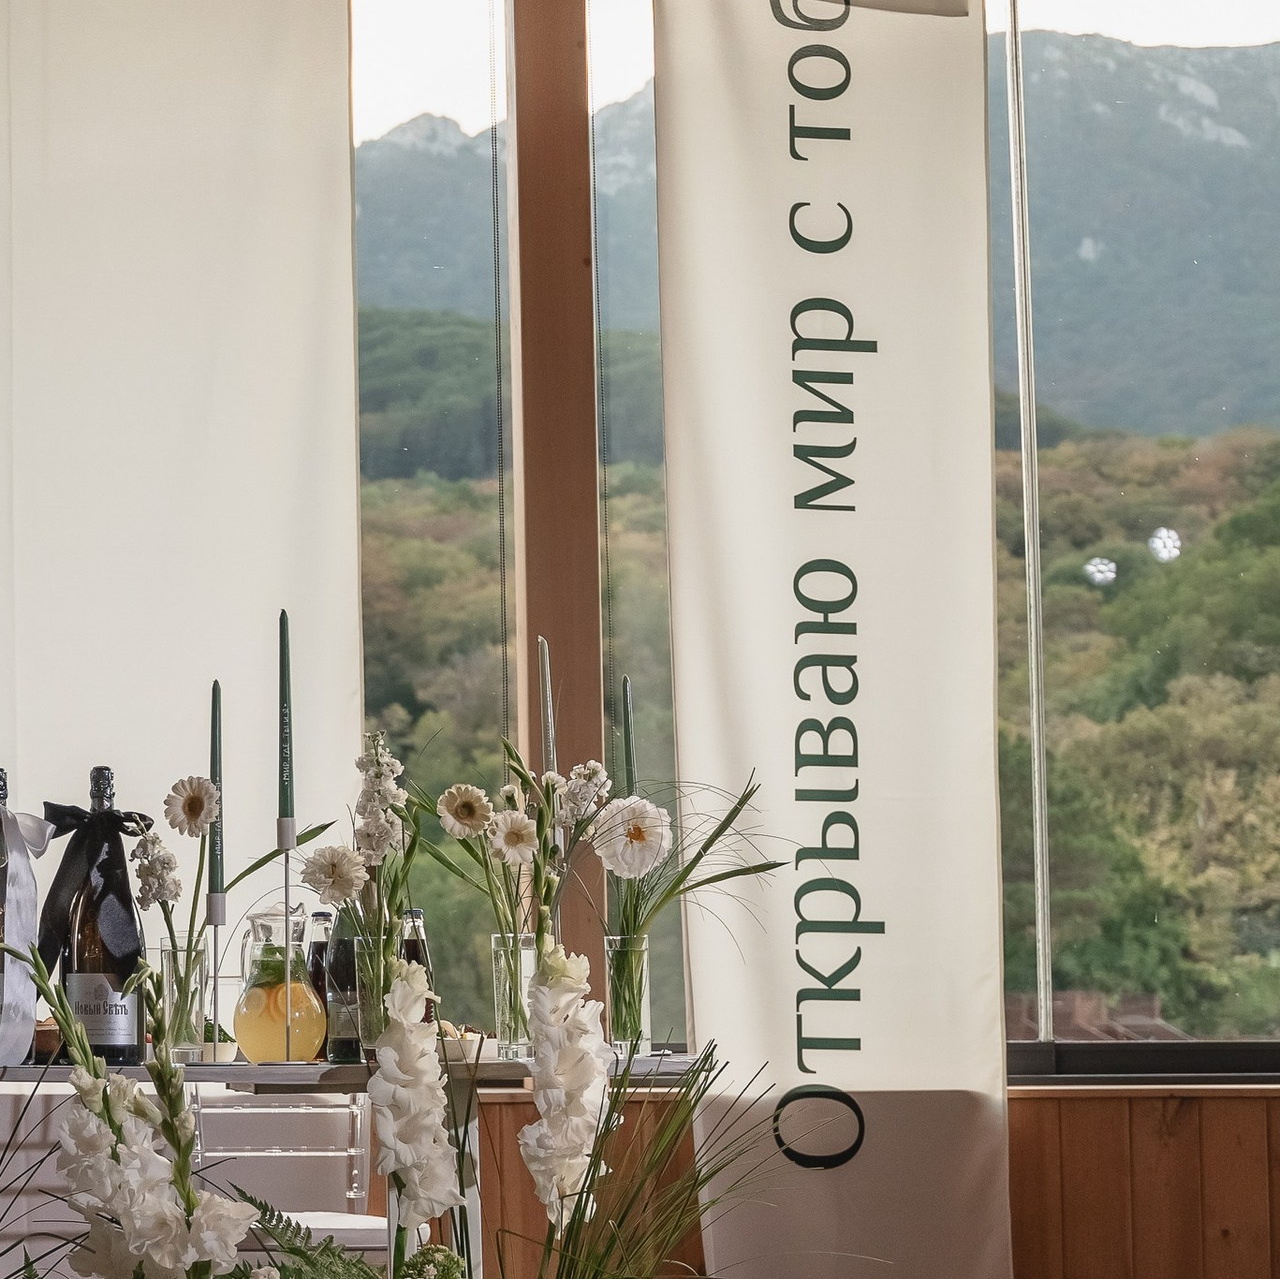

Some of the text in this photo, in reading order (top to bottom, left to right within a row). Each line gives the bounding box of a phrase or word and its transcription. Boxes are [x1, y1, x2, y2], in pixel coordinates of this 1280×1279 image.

[789, 203, 853, 253] с
[790, 298, 878, 511] мир
[772, 559, 885, 1170] Открываю
